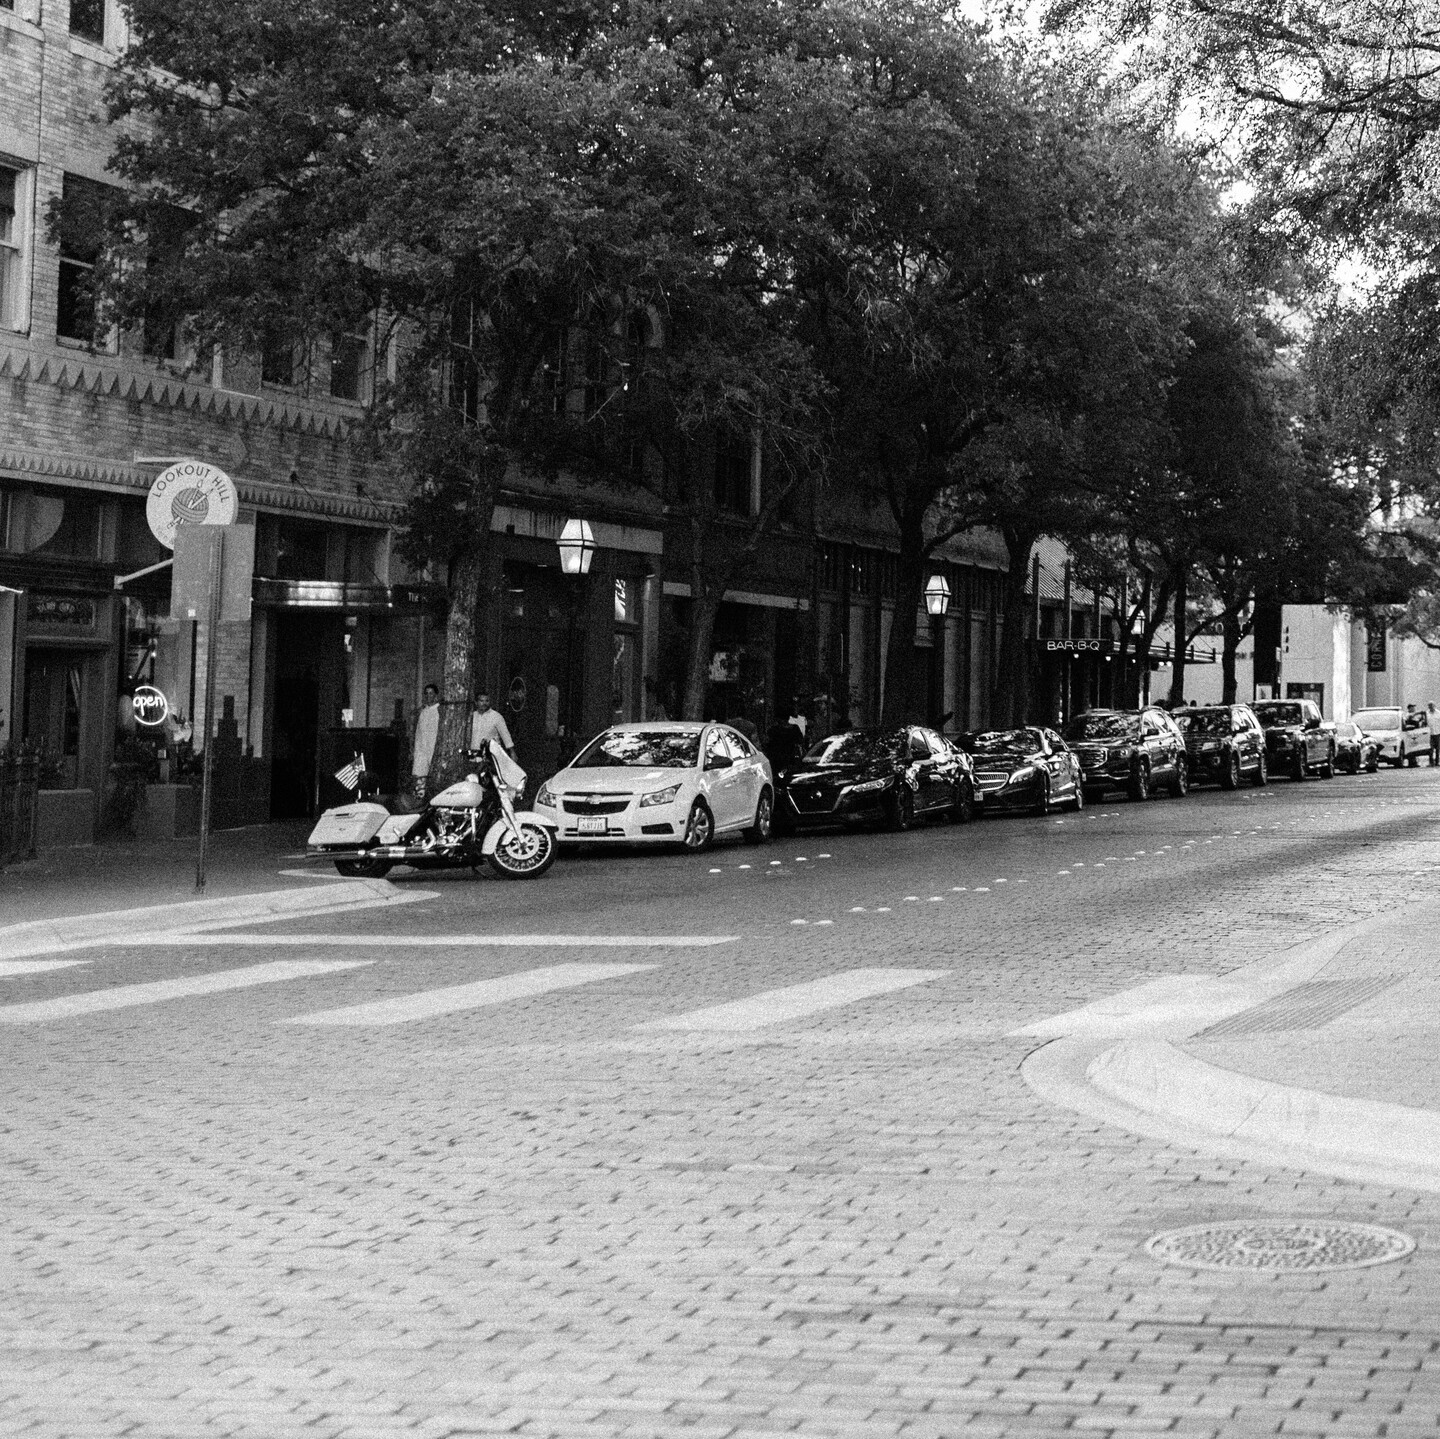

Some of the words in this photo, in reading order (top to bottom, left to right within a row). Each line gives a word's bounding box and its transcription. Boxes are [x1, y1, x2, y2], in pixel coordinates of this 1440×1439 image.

[152, 464, 211, 498] LOOKOUT
[212, 476, 230, 503] HILL
[1047, 641, 1100, 651] BAR-B-Q
[133, 696, 164, 717] open
